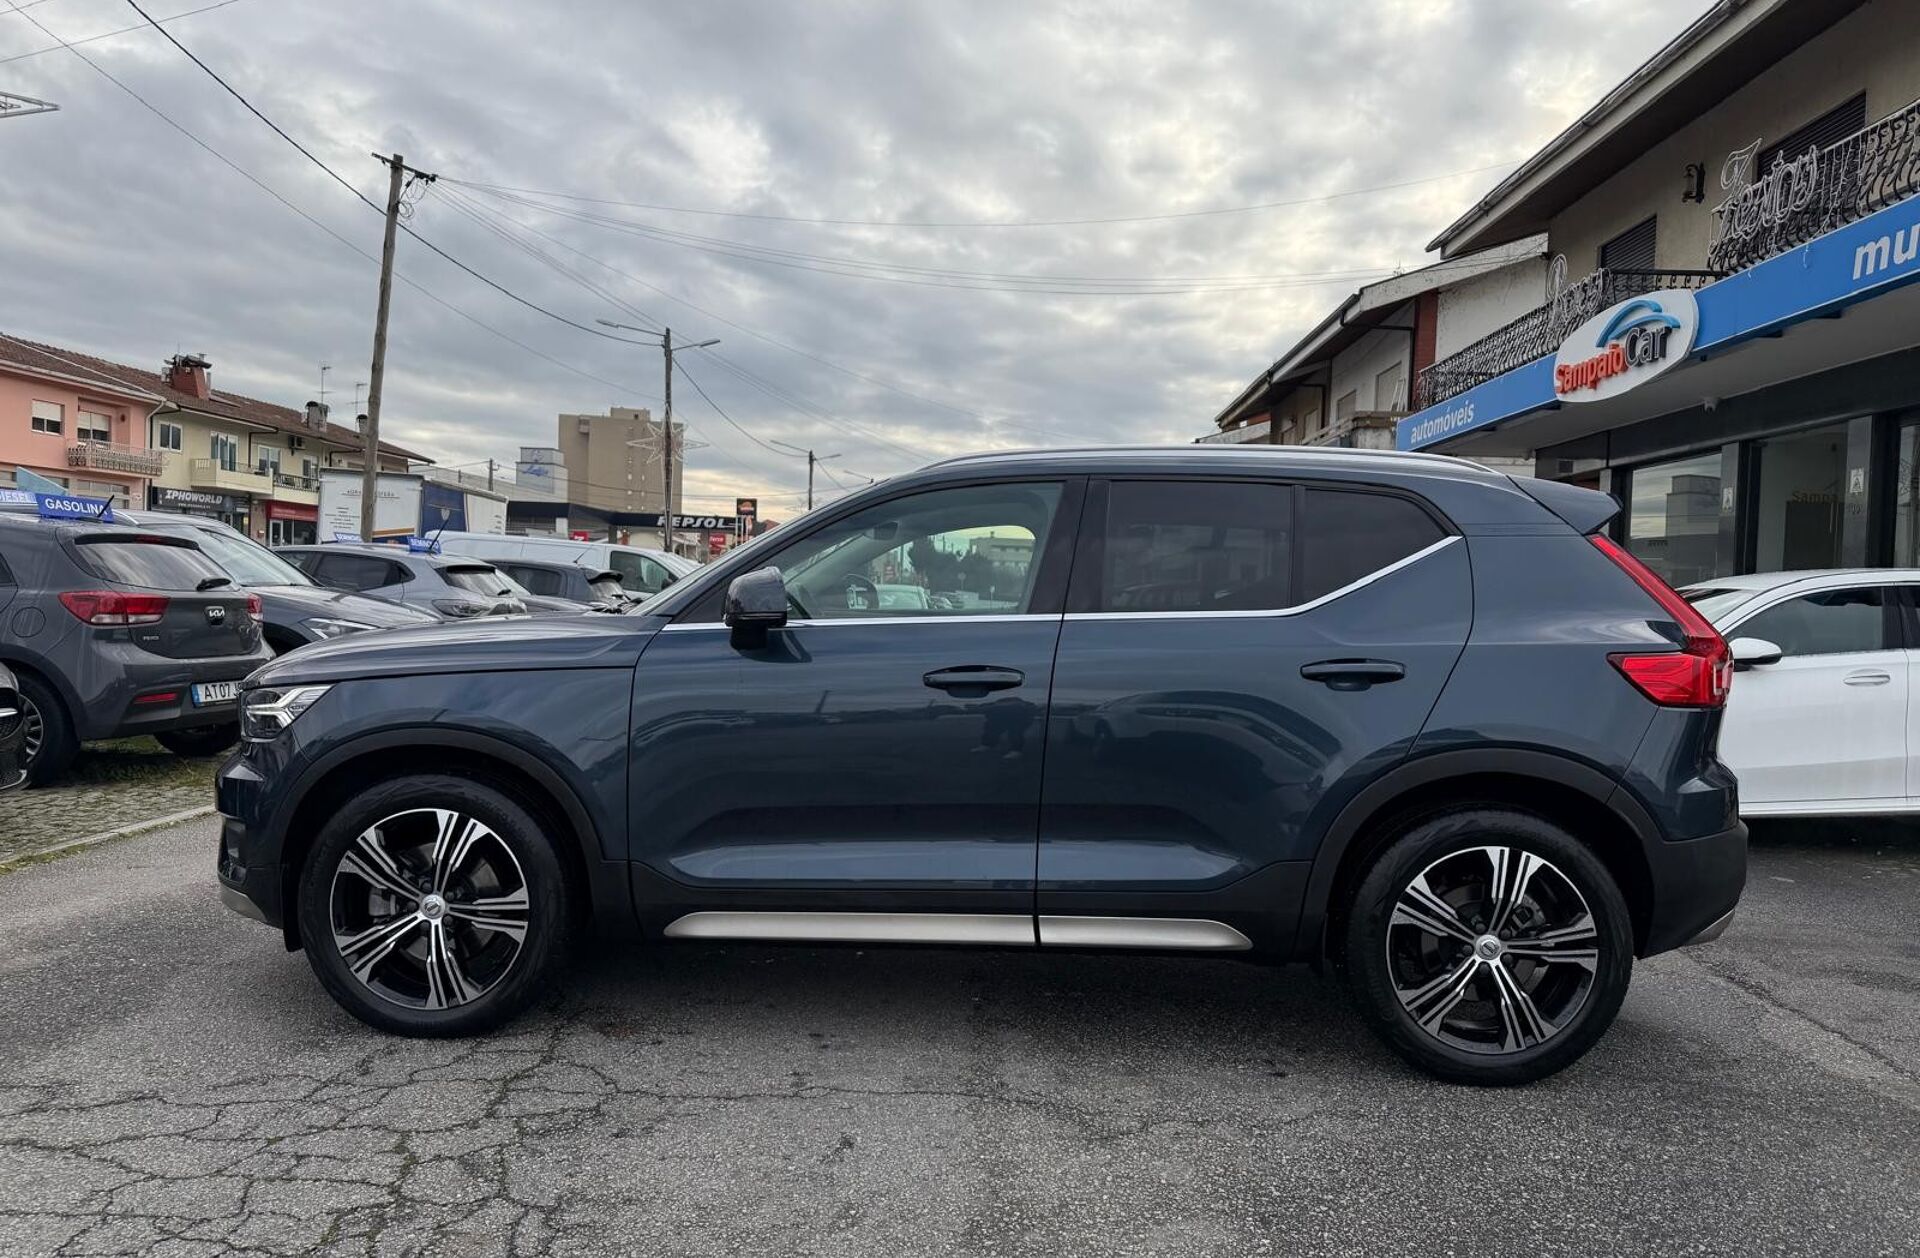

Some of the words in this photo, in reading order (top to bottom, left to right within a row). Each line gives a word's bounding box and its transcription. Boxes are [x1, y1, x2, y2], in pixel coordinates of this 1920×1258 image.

[1853, 222, 1920, 280] mu
[1411, 400, 1475, 444] automóveis
[45, 498, 108, 515] GASOLINA
